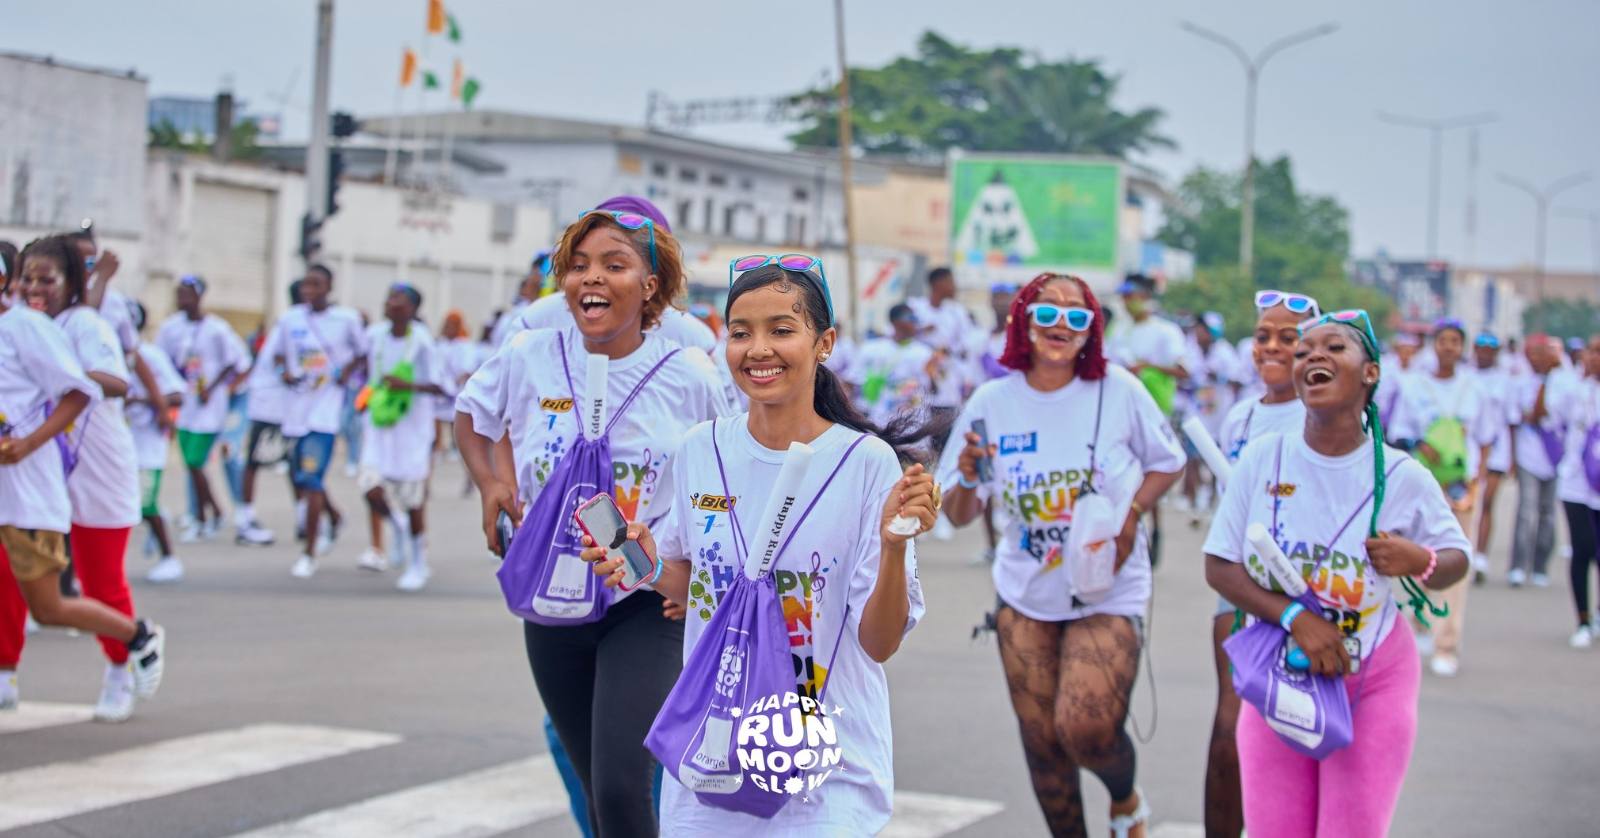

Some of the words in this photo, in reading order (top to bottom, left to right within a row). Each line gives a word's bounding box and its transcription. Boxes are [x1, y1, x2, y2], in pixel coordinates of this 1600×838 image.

[591, 399, 603, 435] Happy
[1017, 468, 1094, 492] HAPPY
[700, 496, 735, 509] BIC
[771, 496, 796, 537] Happy
[762, 540, 778, 565] Run
[550, 586, 582, 598] orange
[712, 565, 818, 597] HPY
[696, 752, 725, 769] orange
